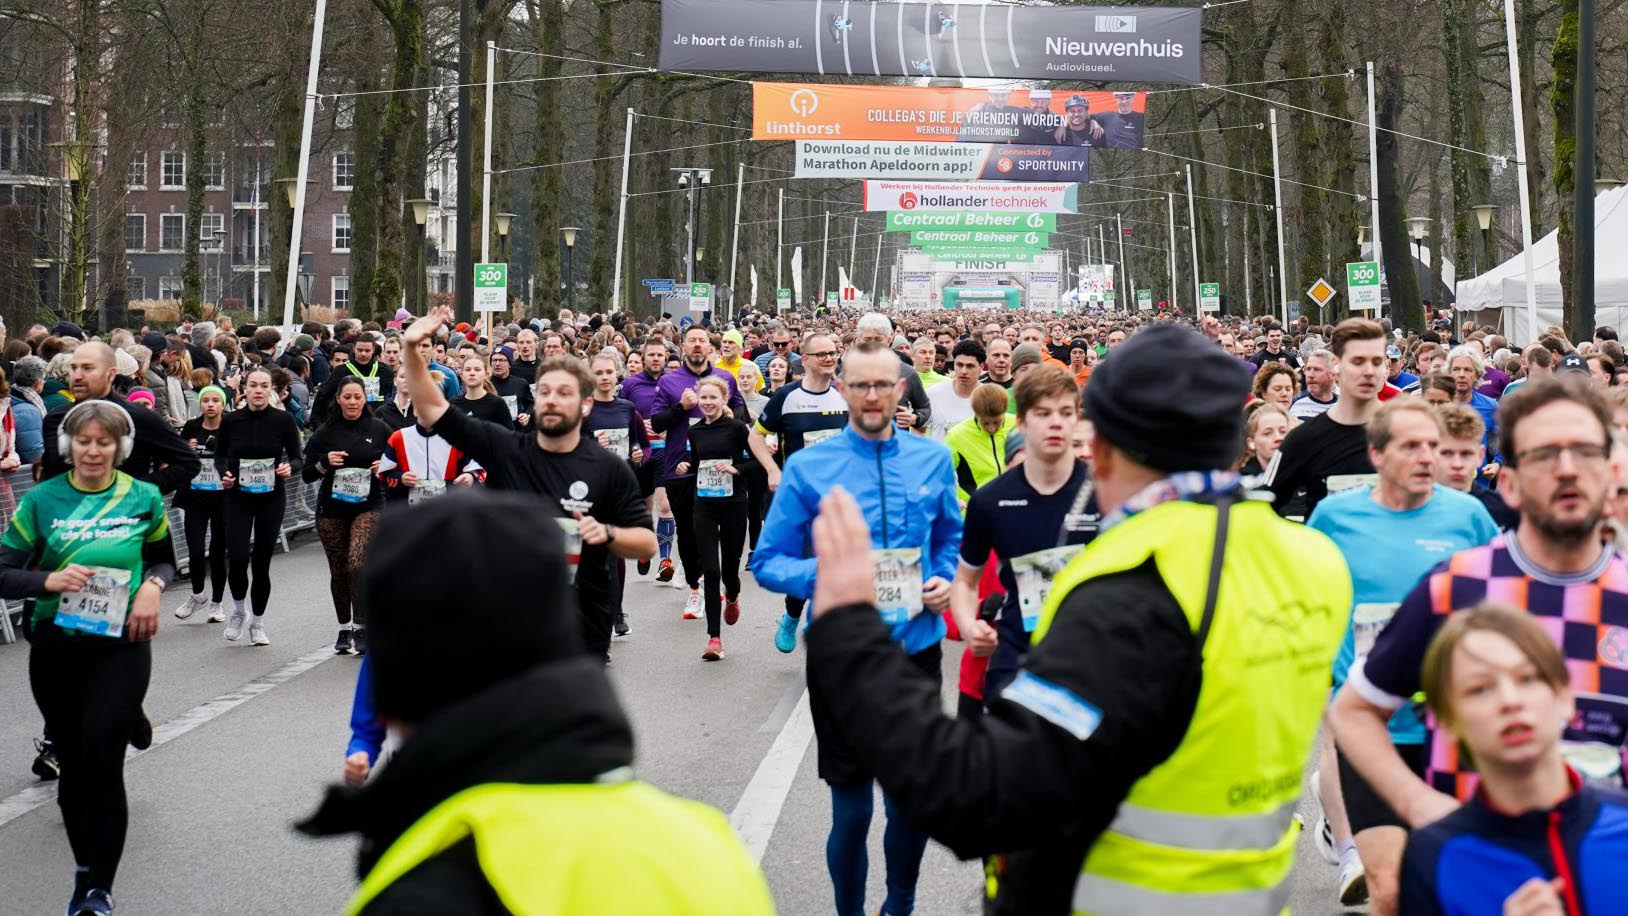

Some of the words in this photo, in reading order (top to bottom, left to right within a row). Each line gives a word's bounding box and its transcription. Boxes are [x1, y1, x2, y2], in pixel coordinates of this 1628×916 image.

[673, 33, 688, 45] Je
[691, 34, 726, 47] hoort
[729, 35, 745, 47] de
[748, 36, 784, 48] finish
[788, 38, 803, 49] al.
[1045, 36, 1184, 58] Nieuwenhuis
[1046, 62, 1116, 73] Audiovisueel.
[867, 109, 926, 123] COLLEGA'S
[929, 110, 946, 124] DIE
[949, 111, 963, 125] JE
[965, 111, 1019, 126] VRIENDEN
[1022, 113, 1069, 128] WORDEN
[766, 121, 841, 136] linthorst
[914, 125, 1020, 137] WERKENBIJLINTHORST.WORLD
[804, 143, 870, 155] Download
[874, 146, 890, 155] nu
[894, 145, 910, 156] de
[914, 146, 982, 157] Midwinter
[1041, 149, 1052, 157] by
[803, 157, 867, 170] Marathon
[870, 159, 940, 173] Apeldoorn
[943, 161, 973, 173] app!
[1018, 159, 1084, 173] SPORTUNITY
[913, 183, 923, 192] bij
[965, 184, 1000, 192] Techniek
[1002, 184, 1023, 193] geeft
[920, 195, 988, 208] hollander
[990, 195, 1048, 208] techniek
[893, 213, 960, 226] Centraal
[964, 213, 1020, 226] Beheer
[916, 231, 973, 242] Centraal
[974, 231, 1020, 243] Beheer
[955, 260, 1006, 270] FINISH
[479, 270, 502, 282] 300
[1352, 269, 1375, 281] 300
[693, 286, 707, 294] 250
[1203, 287, 1217, 295] 250
[78, 596, 110, 615] 4154
